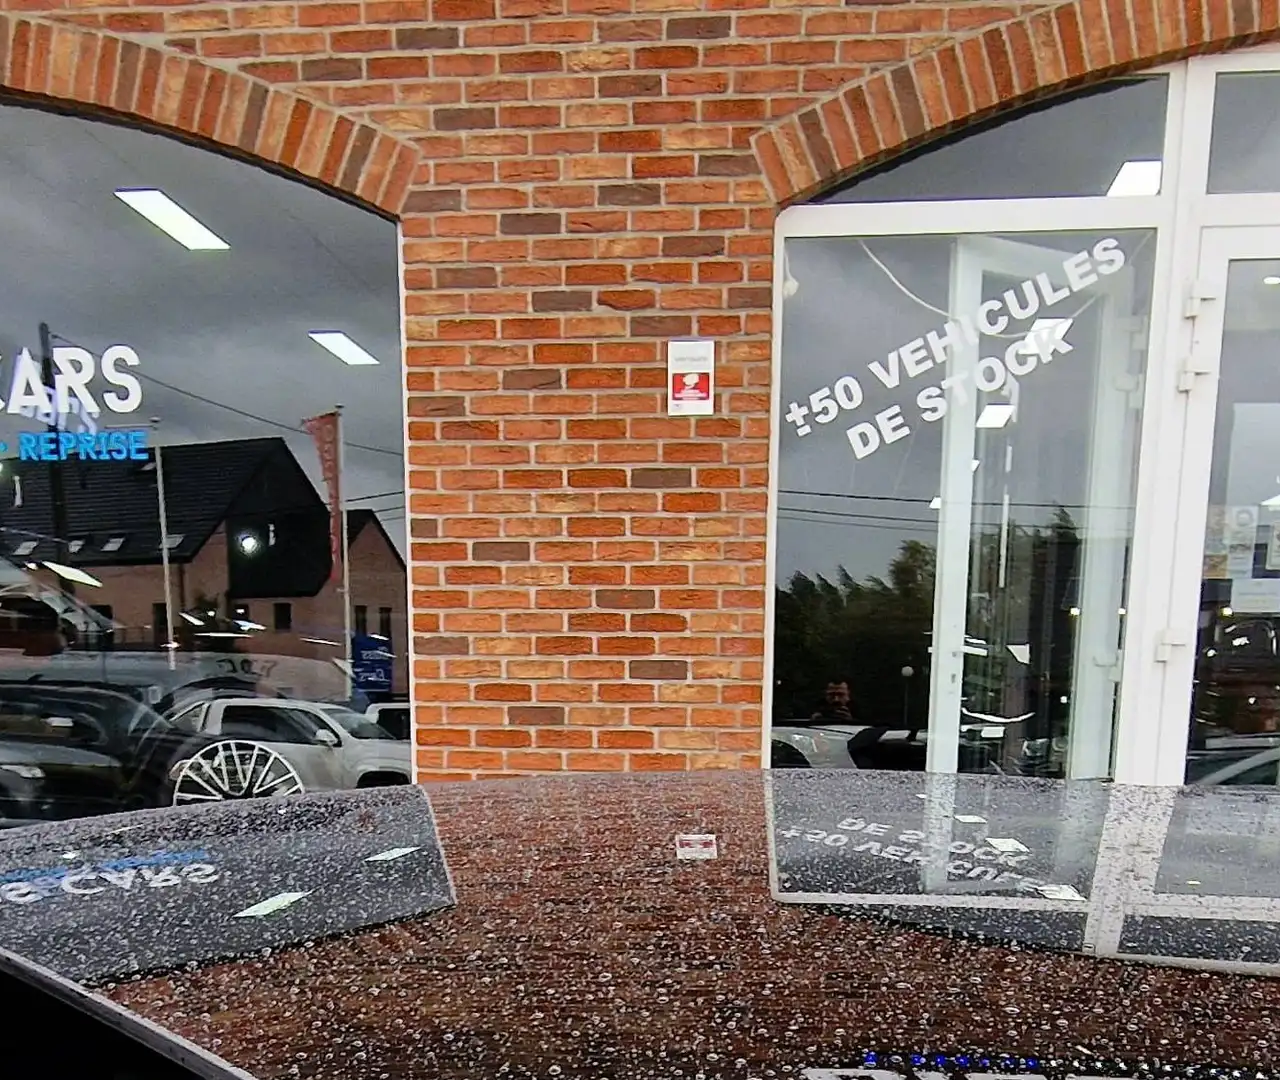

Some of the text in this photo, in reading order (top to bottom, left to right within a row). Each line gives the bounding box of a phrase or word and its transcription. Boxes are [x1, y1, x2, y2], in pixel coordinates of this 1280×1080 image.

[868, 237, 1127, 389] VEHICULES
[19, 430, 149, 462] REPRISE
[846, 329, 1074, 460] DE STOCK
